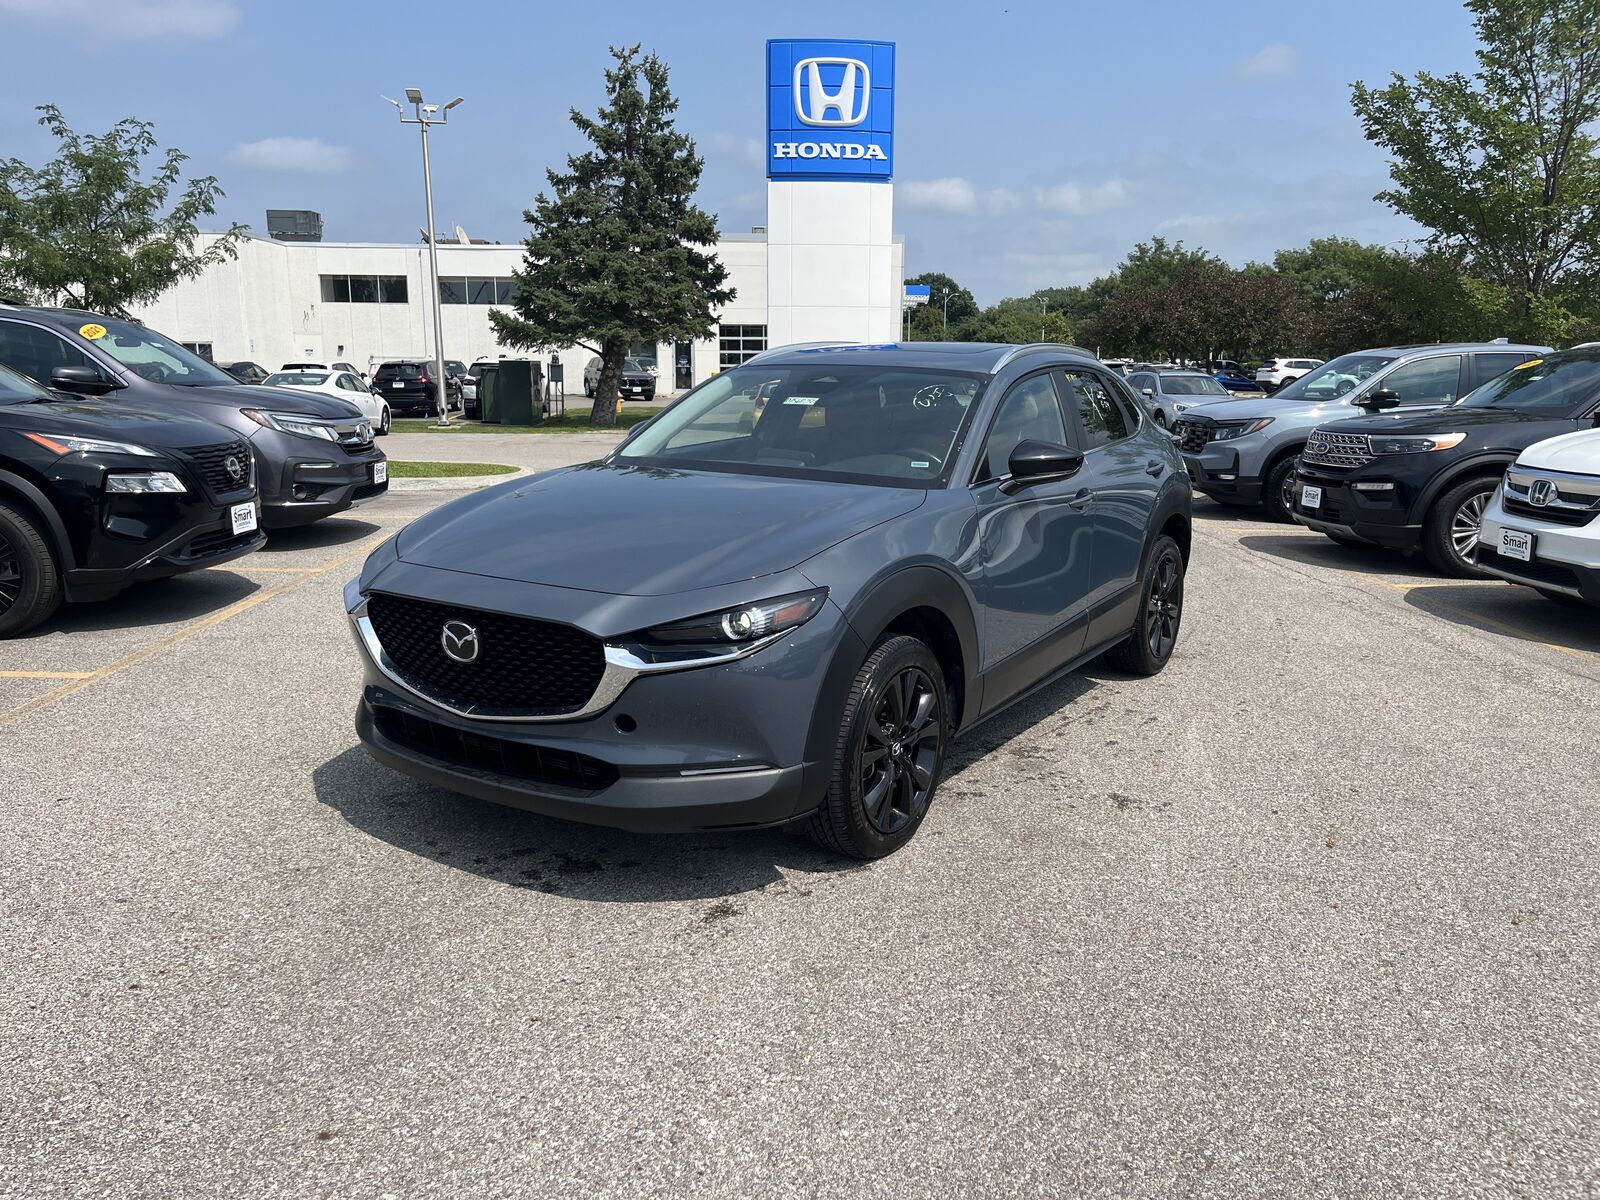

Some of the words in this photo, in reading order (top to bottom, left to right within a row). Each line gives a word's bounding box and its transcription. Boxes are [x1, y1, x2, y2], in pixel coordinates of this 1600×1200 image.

[773, 142, 888, 160] HONDA
[234, 510, 252, 523] Smart
[1503, 535, 1528, 550] Smart
